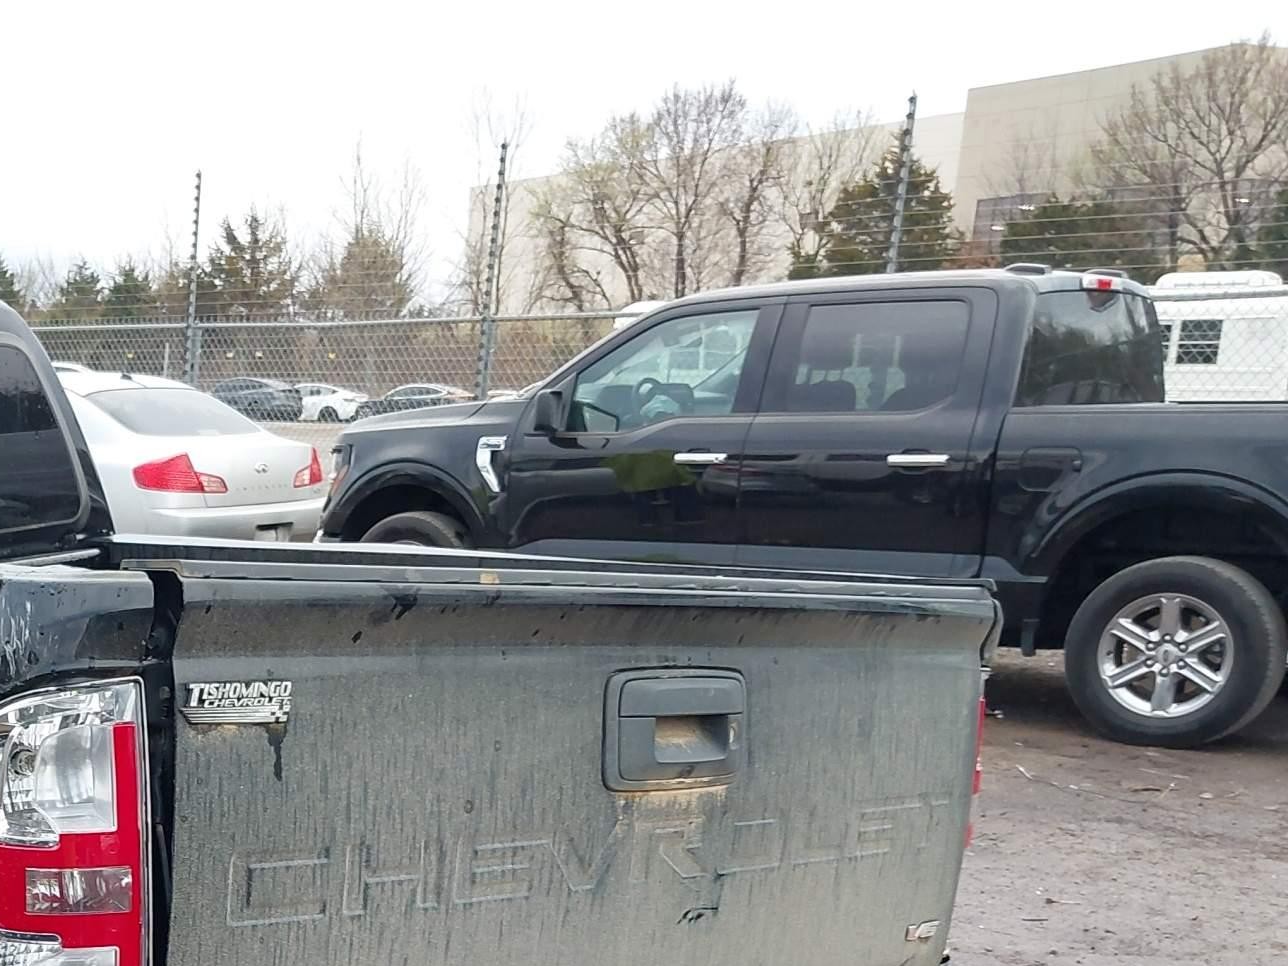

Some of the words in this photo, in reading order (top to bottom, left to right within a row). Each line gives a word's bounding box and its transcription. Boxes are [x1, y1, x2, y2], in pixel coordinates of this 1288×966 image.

[188, 681, 291, 707] TISHOMINGO
[203, 697, 292, 708] CHEVROLET
[226, 799, 950, 928] CHEVROLET
